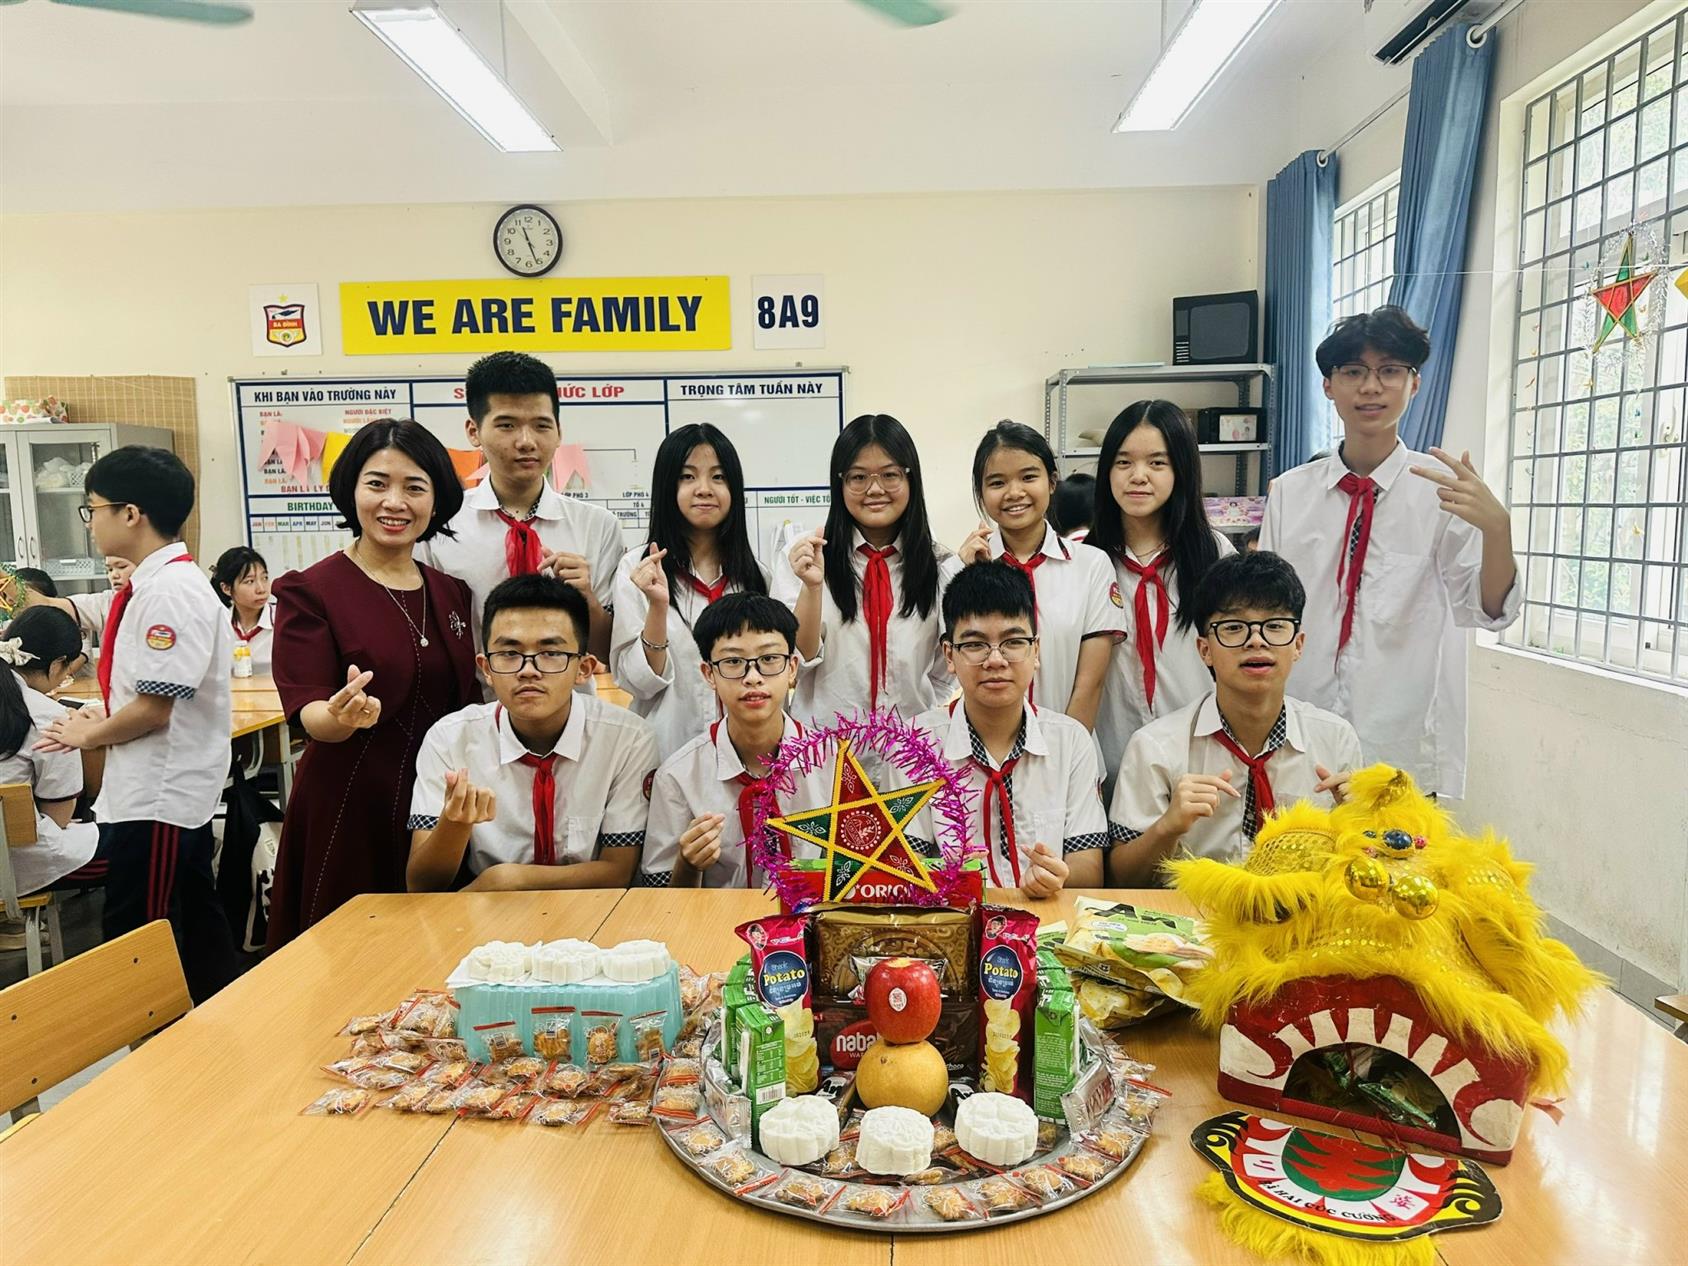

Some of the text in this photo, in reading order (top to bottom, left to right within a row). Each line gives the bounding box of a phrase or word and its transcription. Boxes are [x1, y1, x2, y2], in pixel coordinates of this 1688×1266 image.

[507, 227, 516, 235] 10
[504, 237, 511, 245] 9
[367, 295, 703, 336] WE ARE FAMILY
[757, 294, 819, 329] 8A9
[254, 386, 396, 404] KHI BẠN VÀO TRƯỜNG NÀY
[592, 383, 624, 398] LỚP
[680, 384, 724, 397] TRỌNG
[728, 382, 755, 395] TÂM
[797, 381, 823, 394] NÀY
[287, 501, 334, 511] BIRTHDAY
[764, 494, 785, 504] NGƯỜI
[787, 493, 799, 504] TỐT
[805, 494, 821, 504] VIỆC
[763, 969, 806, 987] Potato
[983, 962, 1019, 979] Potato
